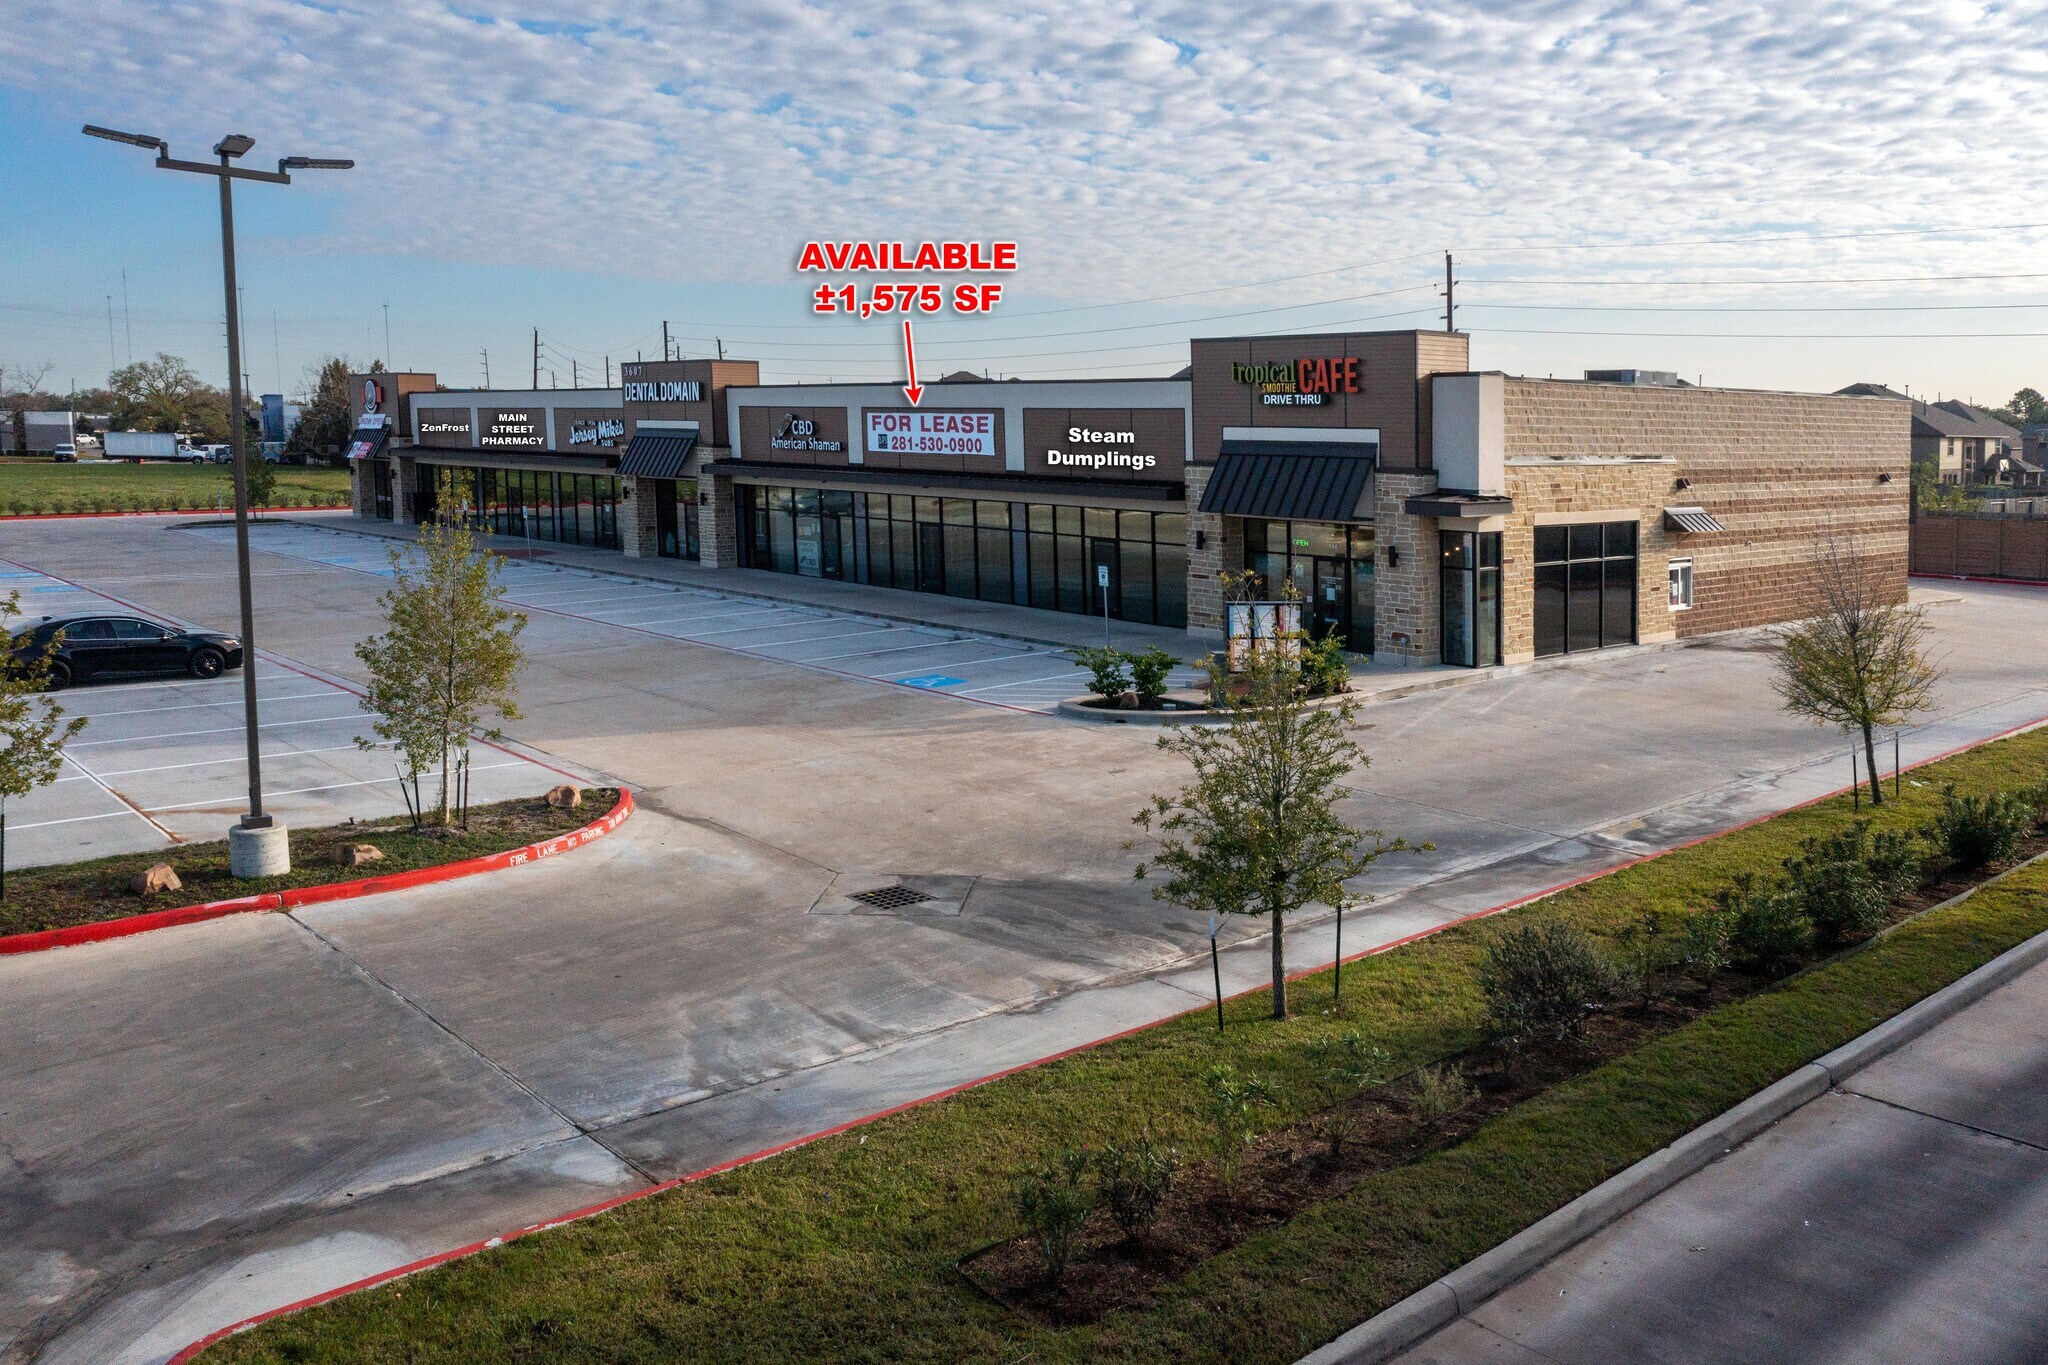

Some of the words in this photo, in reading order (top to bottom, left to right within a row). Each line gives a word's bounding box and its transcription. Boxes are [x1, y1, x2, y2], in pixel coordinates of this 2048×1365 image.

[624, 366, 643, 377] 3607
[1231, 360, 1296, 387] tropical
[1299, 357, 1359, 393] CAFE
[625, 382, 660, 402] DENTAL
[660, 381, 700, 402] DOMAIN
[1261, 382, 1297, 393] SMOOTHIE
[1263, 394, 1293, 405] DRIVE
[1294, 394, 1321, 405] THRU
[791, 420, 813, 435] CBD
[871, 414, 912, 432] FOR
[920, 415, 989, 434] LEASE
[570, 426, 598, 446] Jersey
[771, 436, 807, 450] American
[808, 437, 841, 451] Shaman
[891, 435, 983, 454] 281-530-0900
[1292, 538, 1309, 547] OPEN
[510, 852, 529, 867] FIRE
[536, 843, 559, 858] LANE
[567, 837, 578, 849] NO
[581, 826, 605, 843] PARKING
